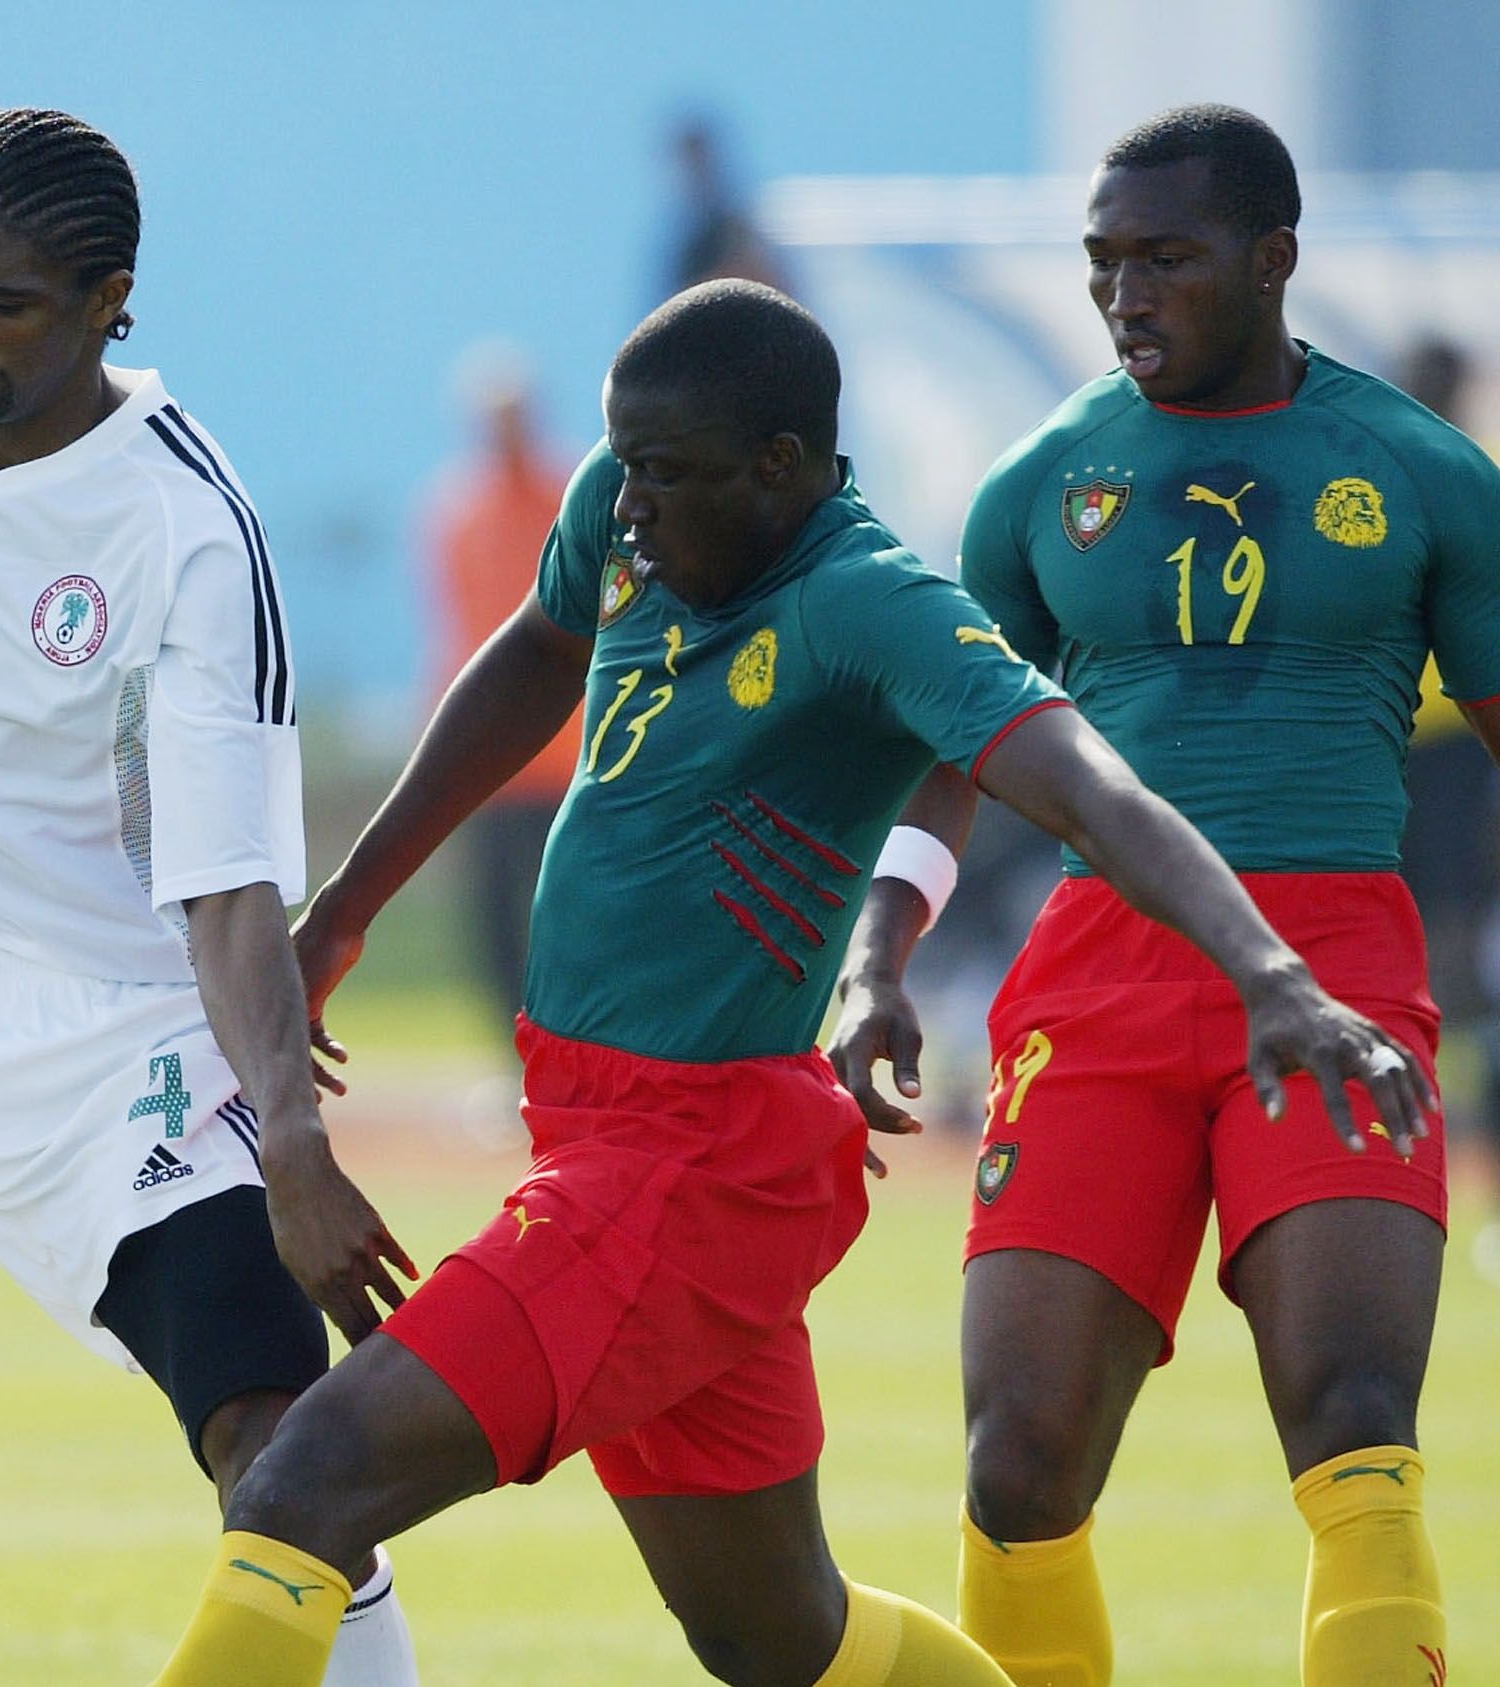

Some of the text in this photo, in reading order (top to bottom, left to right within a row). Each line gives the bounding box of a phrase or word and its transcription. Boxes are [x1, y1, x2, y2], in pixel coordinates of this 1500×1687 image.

[1165, 535, 1265, 645] 19
[586, 668, 673, 782] 13
[127, 1052, 191, 1138] 4
[133, 1163, 194, 1190] adidas
